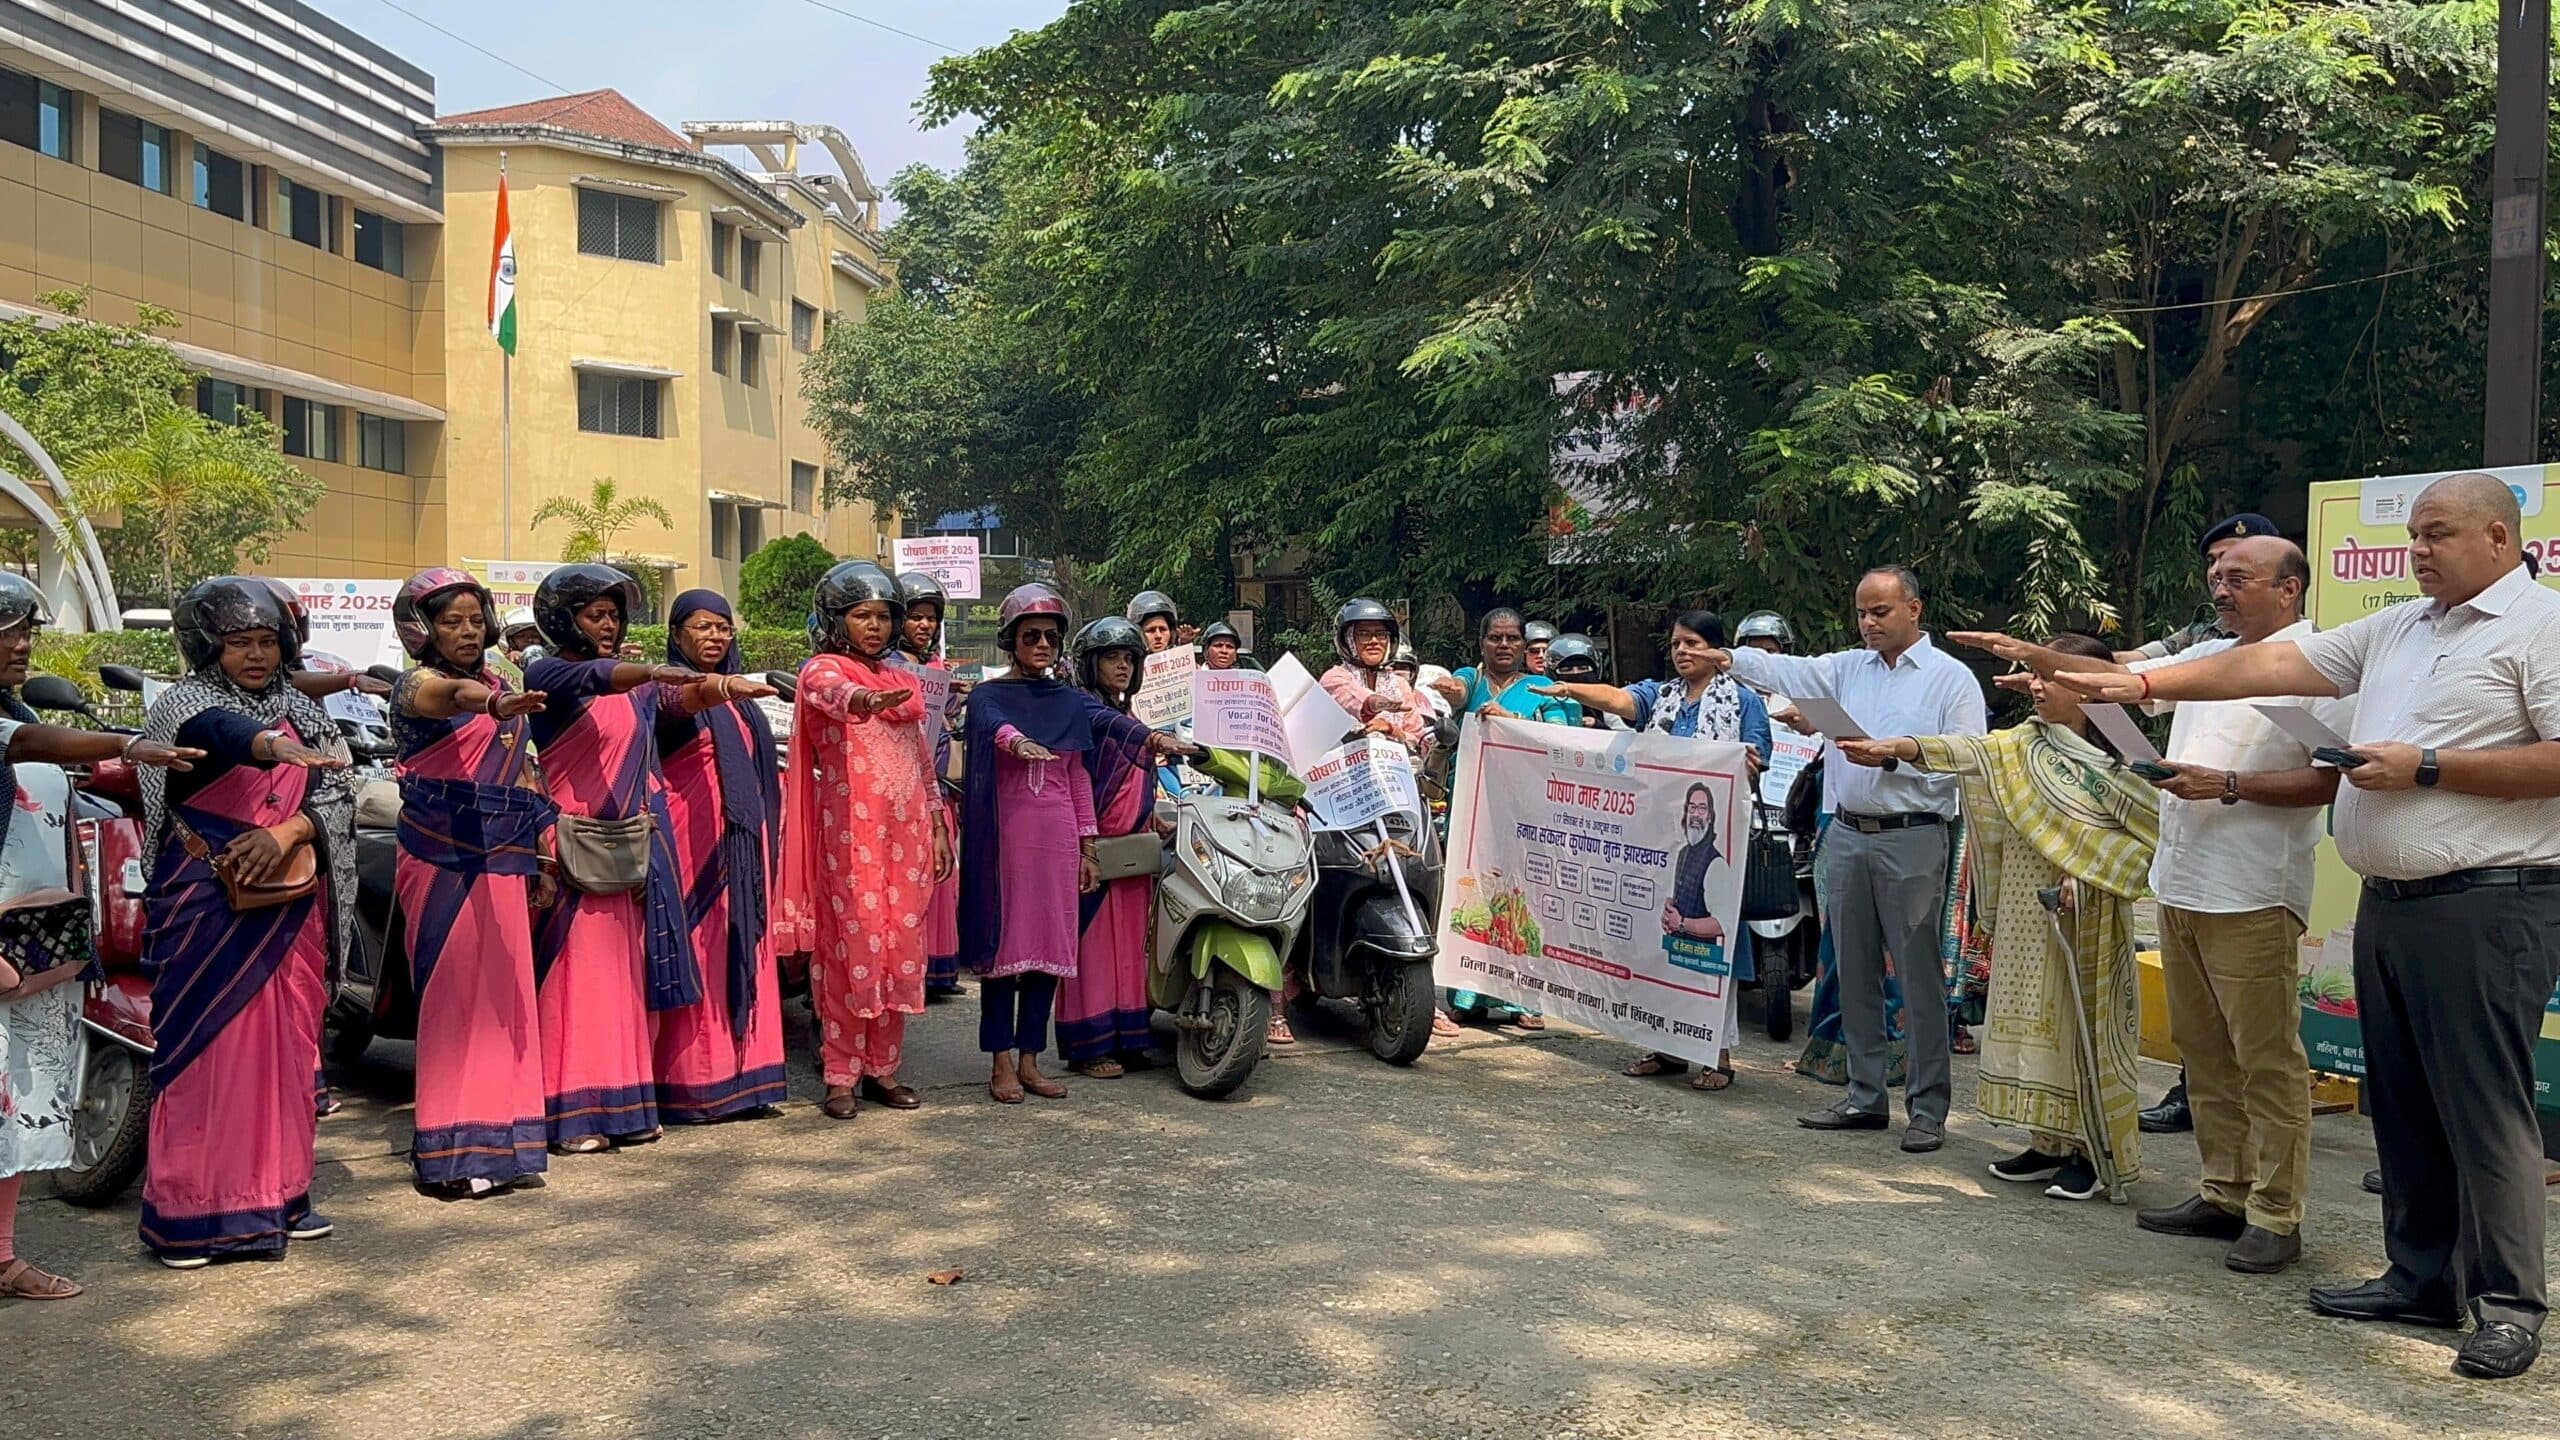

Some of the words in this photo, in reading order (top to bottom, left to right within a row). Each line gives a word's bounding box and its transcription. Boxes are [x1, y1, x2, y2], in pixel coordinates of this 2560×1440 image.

[903, 544, 927, 557] पोषण
[930, 545, 949, 556] माह
[951, 545, 973, 555] 2025
[2333, 537, 2408, 580] पोषण
[340, 595, 393, 610] 2025
[514, 593, 537, 606] मा
[1169, 654, 1191, 671] 2025
[920, 680, 945, 697] 2025
[1207, 677, 1244, 692] पोषण
[1228, 711, 1253, 720] Vocal
[1257, 712, 1269, 723] for
[1307, 760, 1342, 783] पोषण
[1344, 748, 1370, 767] माह
[1373, 748, 1403, 762] 2025
[1546, 772, 1575, 805] पोषण
[1578, 785, 1601, 810] माह
[1603, 789, 1636, 815] 2025
[1516, 822, 1538, 842] हमारा
[1539, 825, 1567, 848] संकल्प
[1569, 830, 1602, 856] कुपोषण
[1603, 840, 1622, 863] मुक्त
[1623, 844, 1669, 868] झारखण्ड
[1460, 955, 1486, 973] जिला
[1488, 963, 1515, 982] प्रशासन
[1547, 982, 1576, 1001] कल्याण
[1612, 1001, 1628, 1019] पूर्वी
[1673, 1020, 1713, 1041] झारखंड
